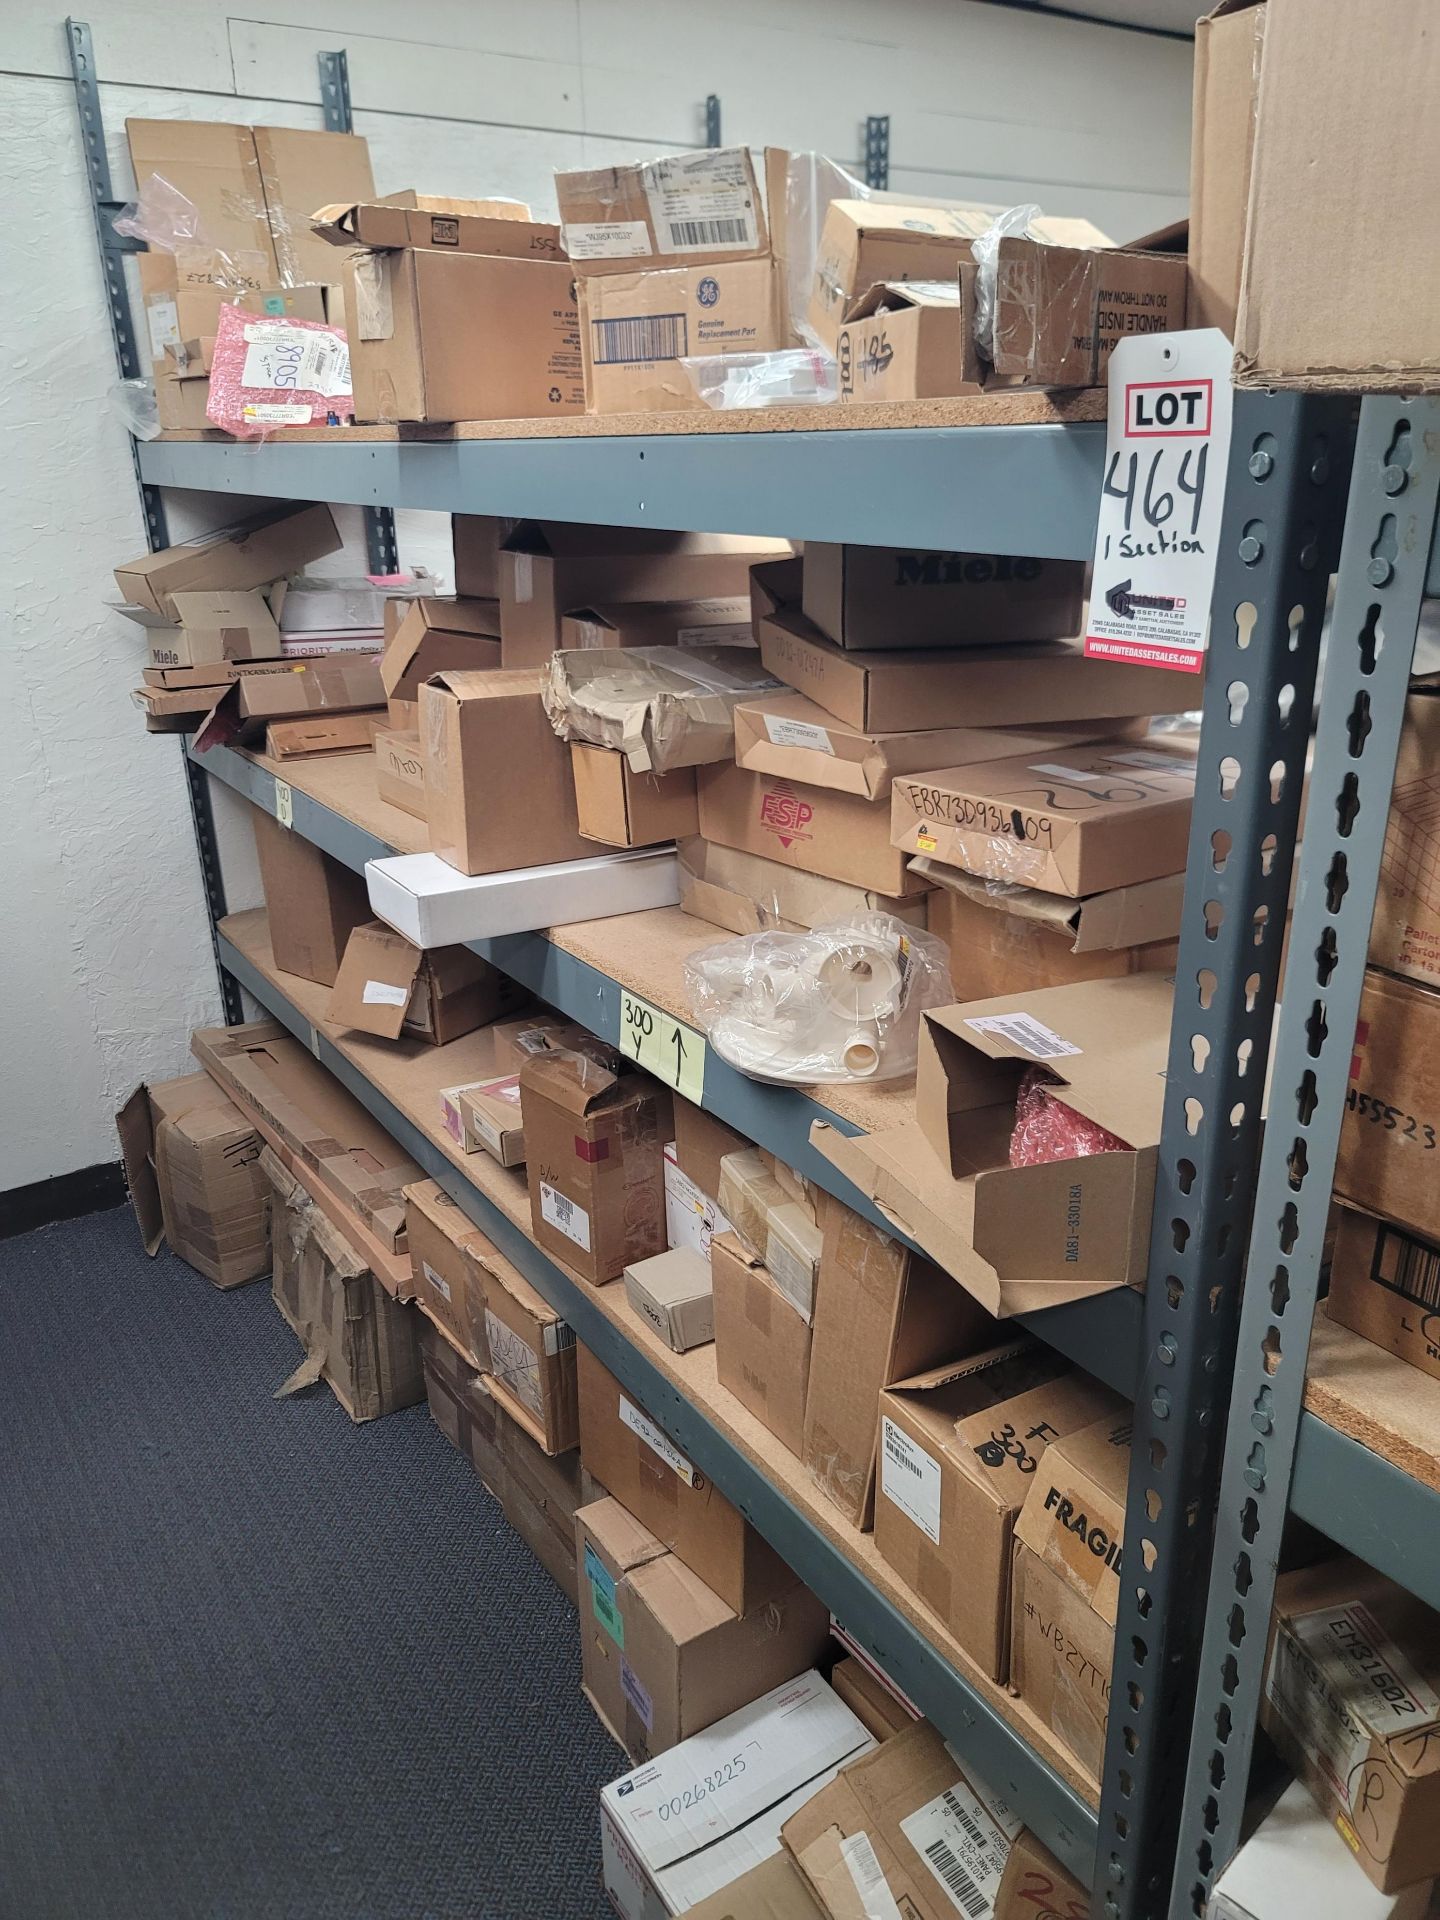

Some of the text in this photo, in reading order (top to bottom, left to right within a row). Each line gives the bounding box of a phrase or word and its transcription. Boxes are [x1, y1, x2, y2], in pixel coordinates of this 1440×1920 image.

[1114, 290, 1139, 307] THROW
[1141, 292, 1155, 307] NOT
[1156, 294, 1167, 308] DO
[697, 319, 725, 330] Genuine
[697, 326, 757, 340] Replacement Part
[1098, 311, 1167, 332] HANDLE INSID
[274, 345, 305, 388] 8905
[1135, 391, 1203, 426] LOT
[1103, 442, 1209, 535] 464
[1119, 530, 1205, 559] Section
[894, 553, 1042, 586] Miele
[1158, 611, 1185, 620] SALES
[153, 649, 179, 664] Miele
[283, 646, 332, 656] PRIORITY
[1089, 641, 1197, 666] WWW.UNITEDASSETSALES.COM
[760, 793, 813, 829] FSP
[625, 998, 654, 1036] 300
[631, 1030, 642, 1061] Y
[893, 1430, 914, 1453] Electrolux
[991, 1423, 1037, 1474] 300
[1043, 1485, 1124, 1577] FRAGIL
[658, 1753, 746, 1822] 00268225
[941, 1806, 952, 1817] 05
[973, 1806, 982, 1817] 05
[957, 1846, 986, 1883] W10195791
[962, 1835, 992, 1876] PANEL-CNTL
[985, 1853, 1003, 1877] 95047
